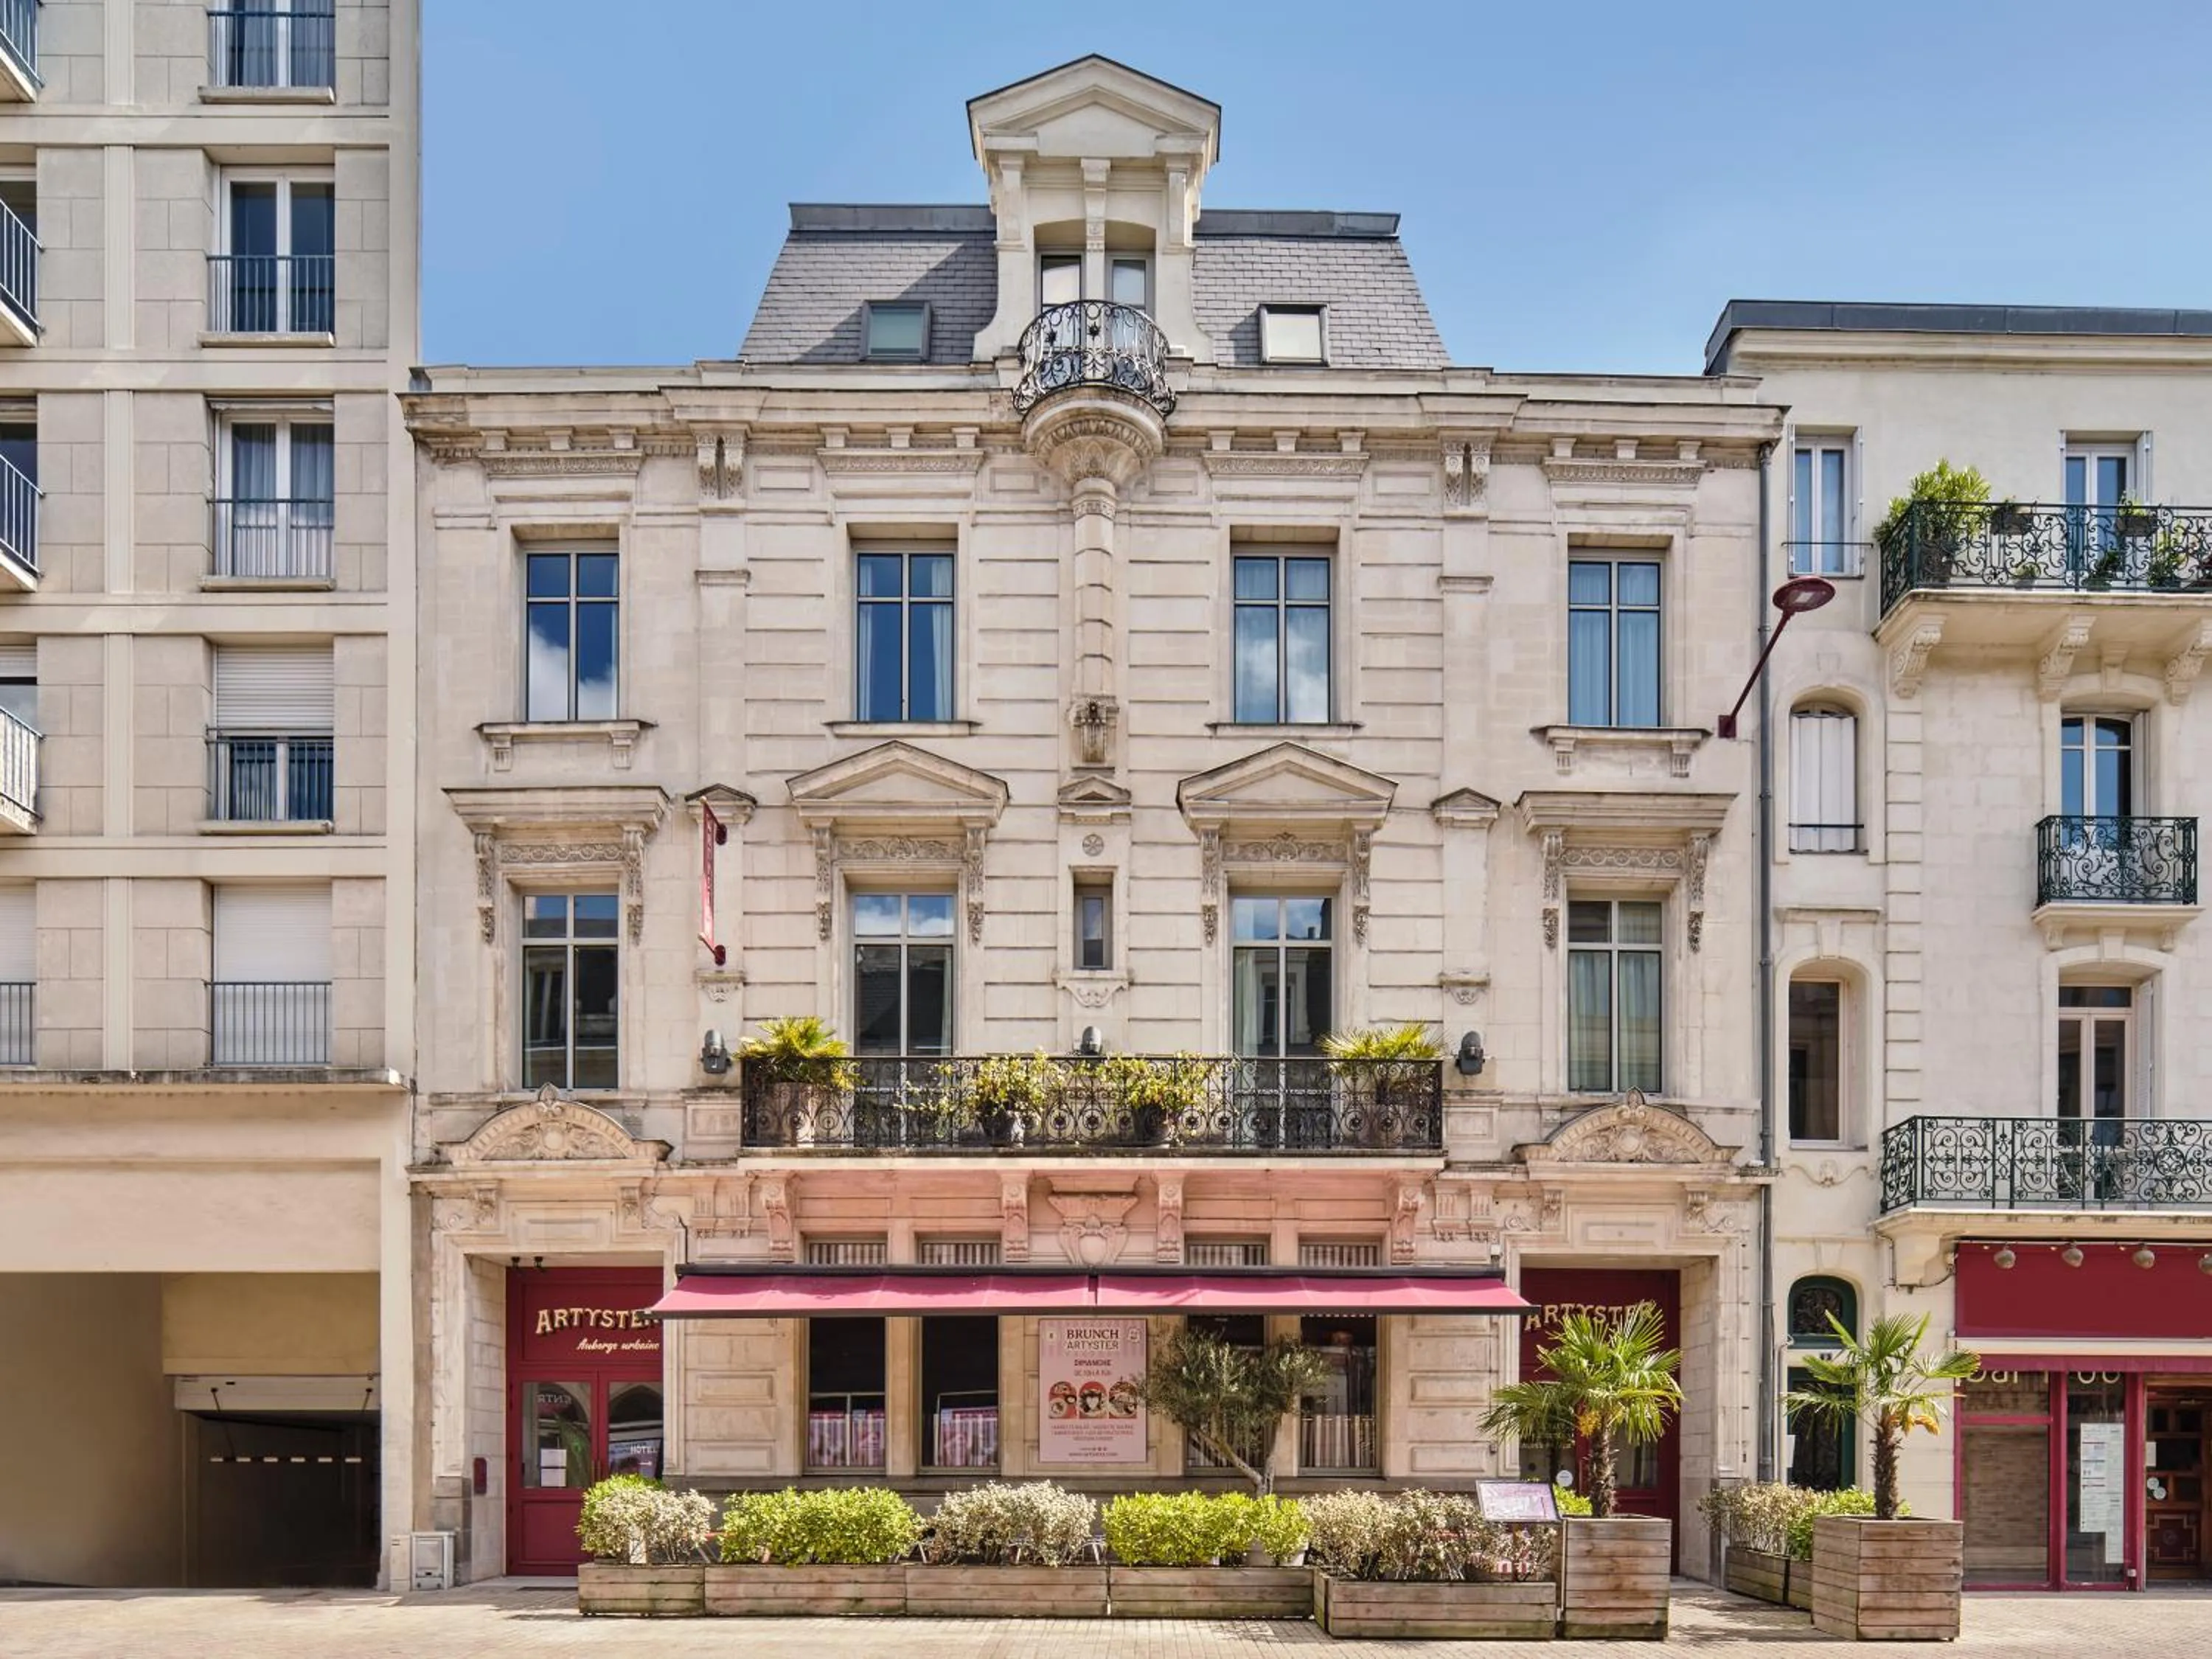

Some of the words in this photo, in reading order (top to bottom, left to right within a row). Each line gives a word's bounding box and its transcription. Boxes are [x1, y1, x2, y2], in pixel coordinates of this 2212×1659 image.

[1067, 1329, 1119, 1339] BRUNCH
[577, 1338, 617, 1354] Auberge
[622, 1338, 660, 1350] urbaine
[1067, 1340, 1119, 1350] ARTYSTER
